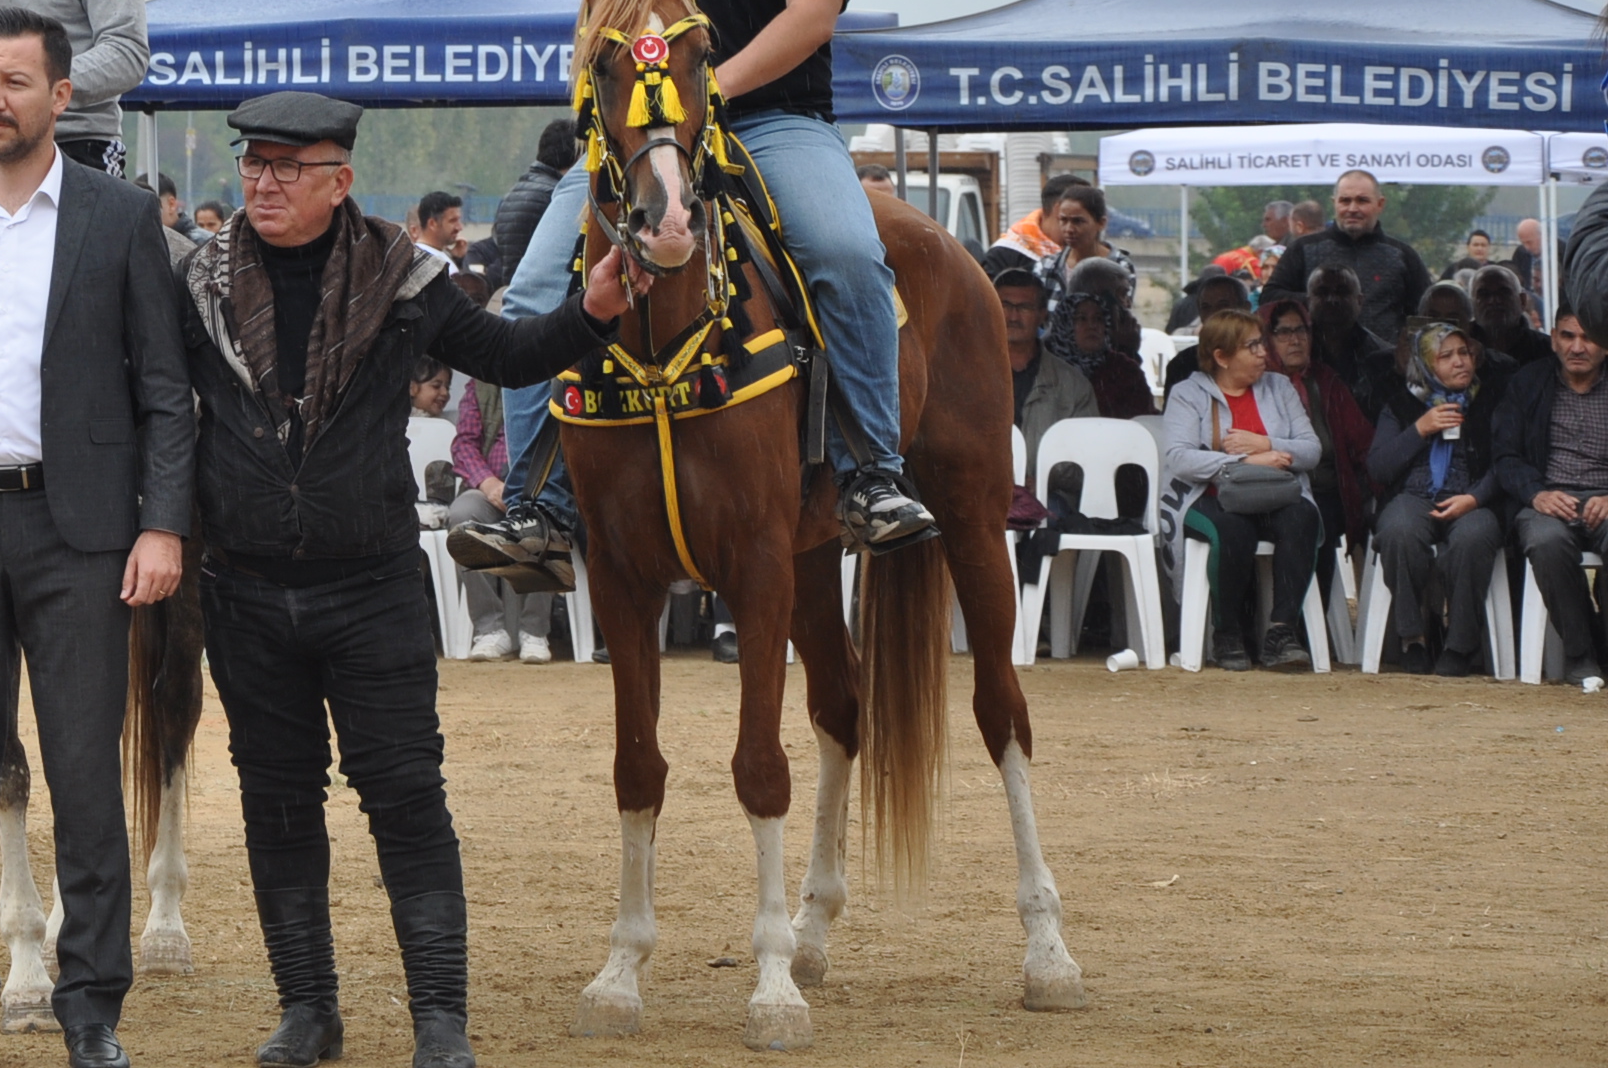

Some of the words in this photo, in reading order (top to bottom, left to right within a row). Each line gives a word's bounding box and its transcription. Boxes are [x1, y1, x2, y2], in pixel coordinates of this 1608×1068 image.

[1258, 58, 1573, 112] BELEDİYESİ
[1165, 152, 1232, 171] SALİHLİ
[1237, 152, 1313, 169] TİCARET
[1317, 153, 1341, 168] VE
[1345, 151, 1412, 168] SANAYİ
[1416, 154, 1473, 168] ODASI
